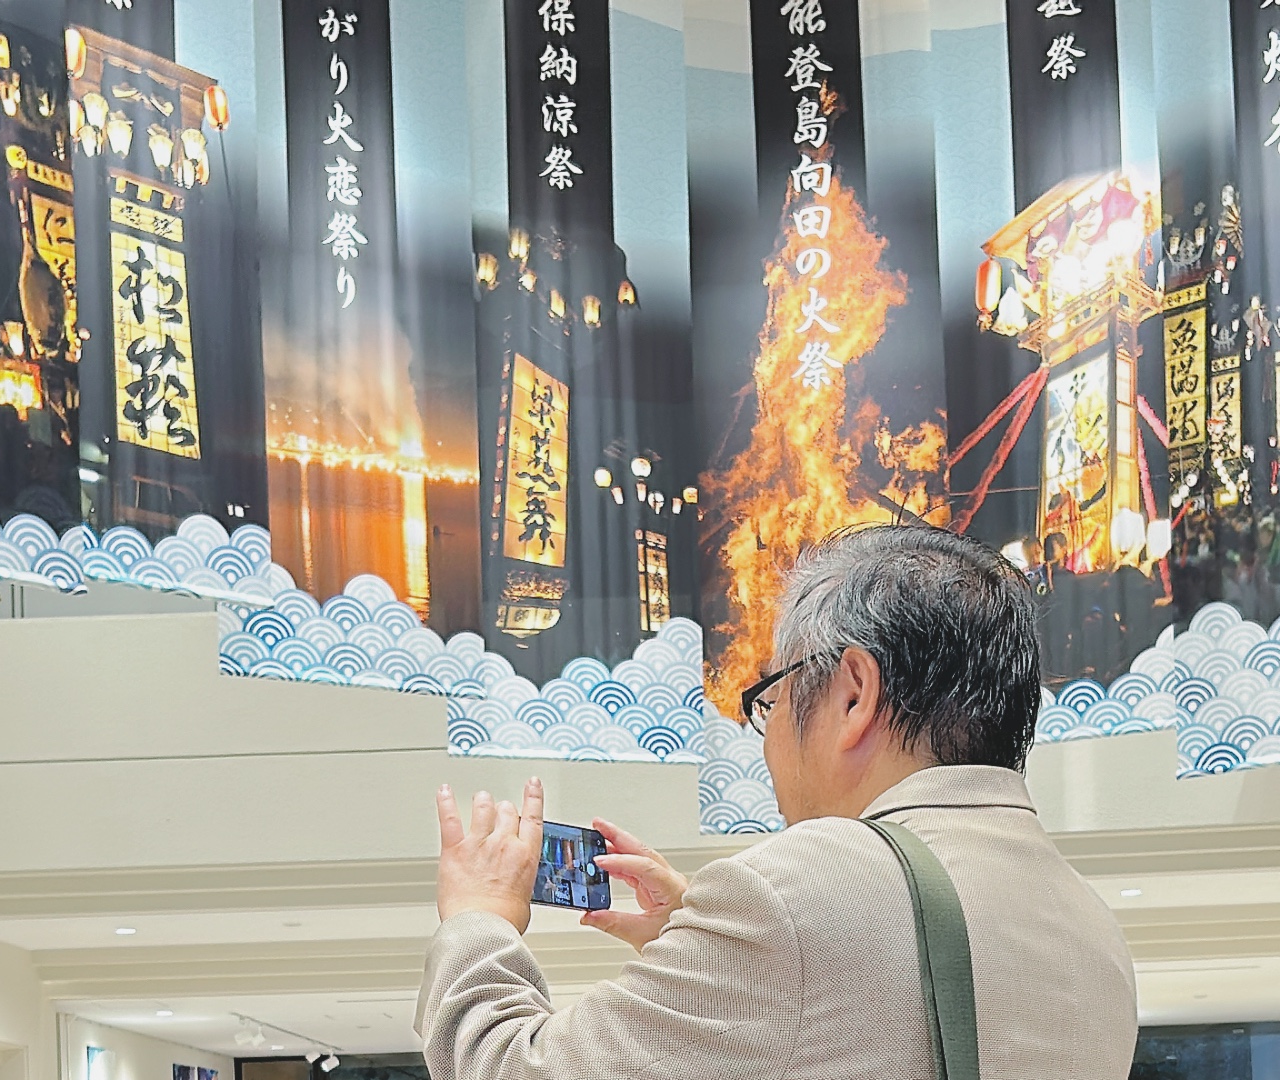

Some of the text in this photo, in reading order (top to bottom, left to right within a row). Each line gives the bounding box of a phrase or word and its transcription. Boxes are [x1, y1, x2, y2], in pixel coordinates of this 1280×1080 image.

[318, 6, 369, 310] がり火恋祭り
[538, 0, 584, 191] 保納涼祭
[780, 0, 845, 392] 能登島向田の火祭
